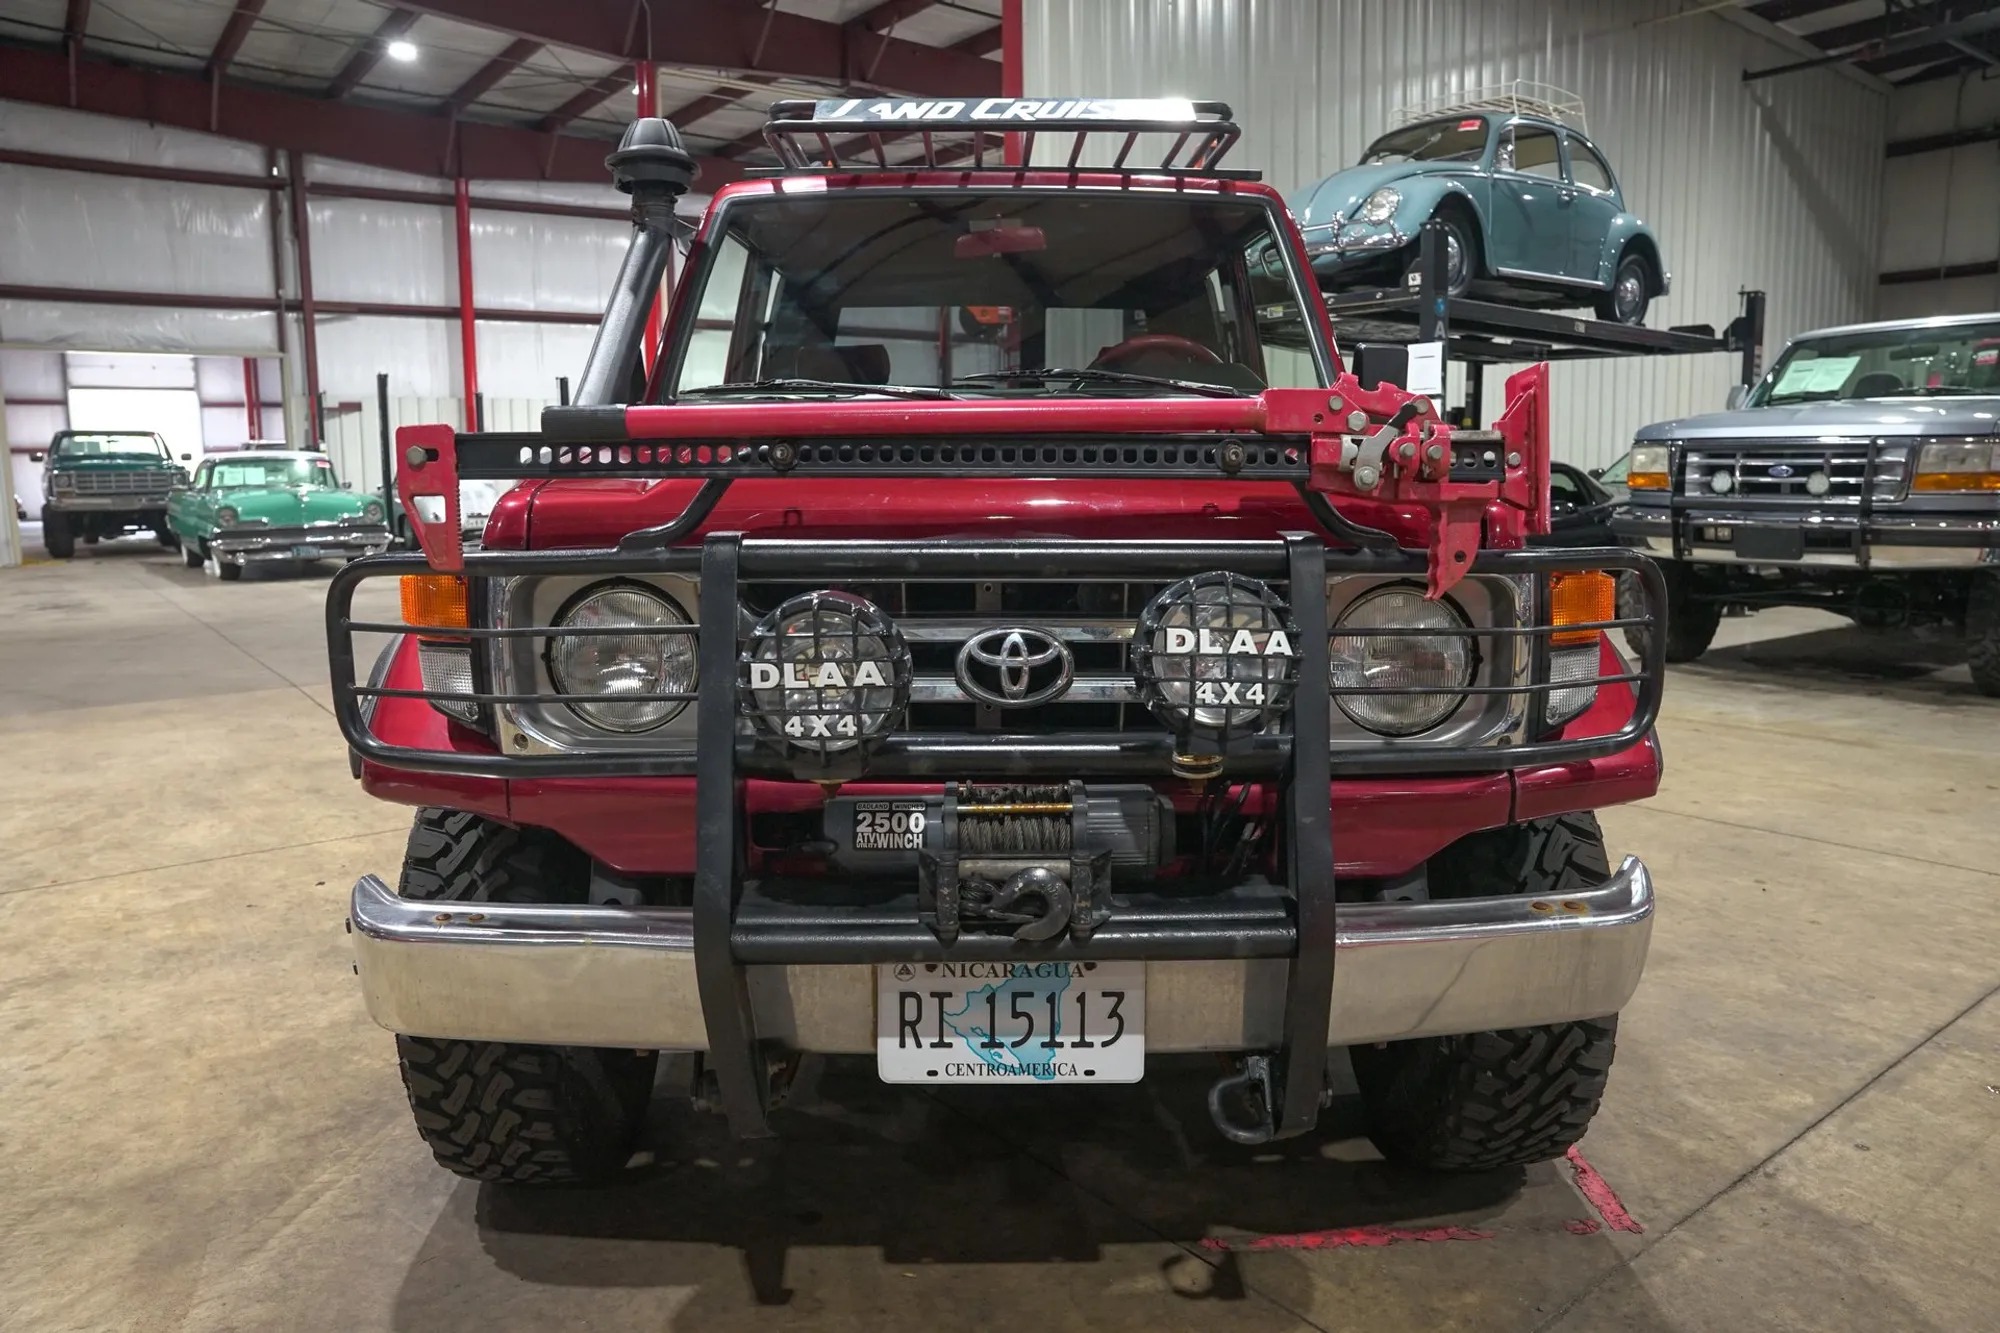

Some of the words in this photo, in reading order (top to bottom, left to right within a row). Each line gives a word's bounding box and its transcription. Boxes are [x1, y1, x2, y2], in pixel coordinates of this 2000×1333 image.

[969, 98, 1160, 121] CRUIS
[1166, 627, 1294, 656] DLAA
[750, 661, 886, 689] DLAA
[1195, 682, 1265, 705] 4X4
[784, 714, 857, 738] 4X4
[856, 812, 925, 833] 2500
[876, 833, 923, 849] WINCH
[941, 962, 1085, 978] NICARAGUA
[980, 991, 1125, 1049] 15113
[945, 1062, 1079, 1077] CENTROAMERICA
